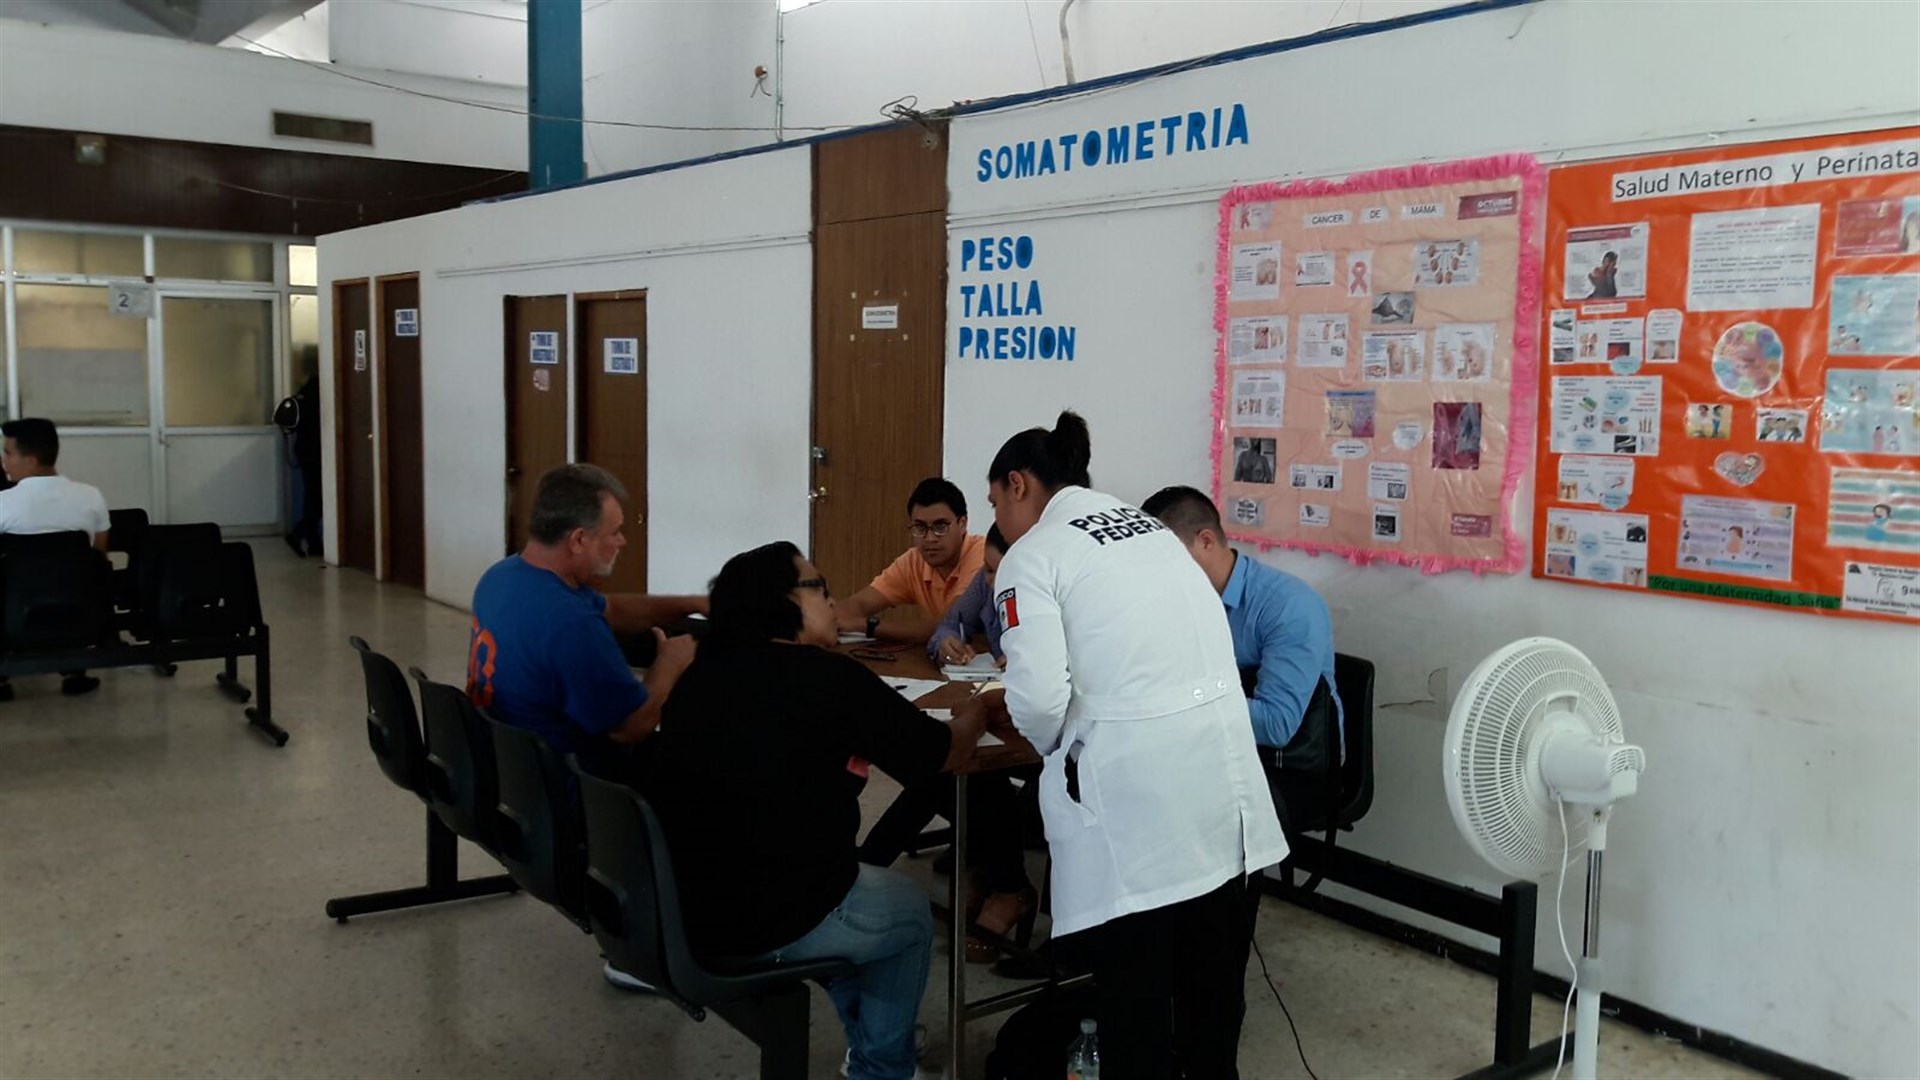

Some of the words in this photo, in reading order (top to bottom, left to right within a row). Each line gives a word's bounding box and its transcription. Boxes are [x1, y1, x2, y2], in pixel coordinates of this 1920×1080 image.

[977, 103, 1249, 183] SOMATOMETRIA
[1614, 172, 1670, 199] Salud
[1678, 165, 1773, 191] Materno
[1791, 162, 1805, 183] y
[1816, 149, 1920, 176] Perinata
[1311, 213, 1345, 225] CANCER
[1368, 208, 1382, 220] DE
[1410, 204, 1437, 215] MAMA
[961, 235, 1034, 272] PESO
[118, 293, 129, 308] 2
[960, 279, 1043, 318] TALLA
[958, 325, 1077, 361] PRESION
[1067, 507, 1157, 531] POLIC
[1088, 518, 1170, 545] FEDERA
